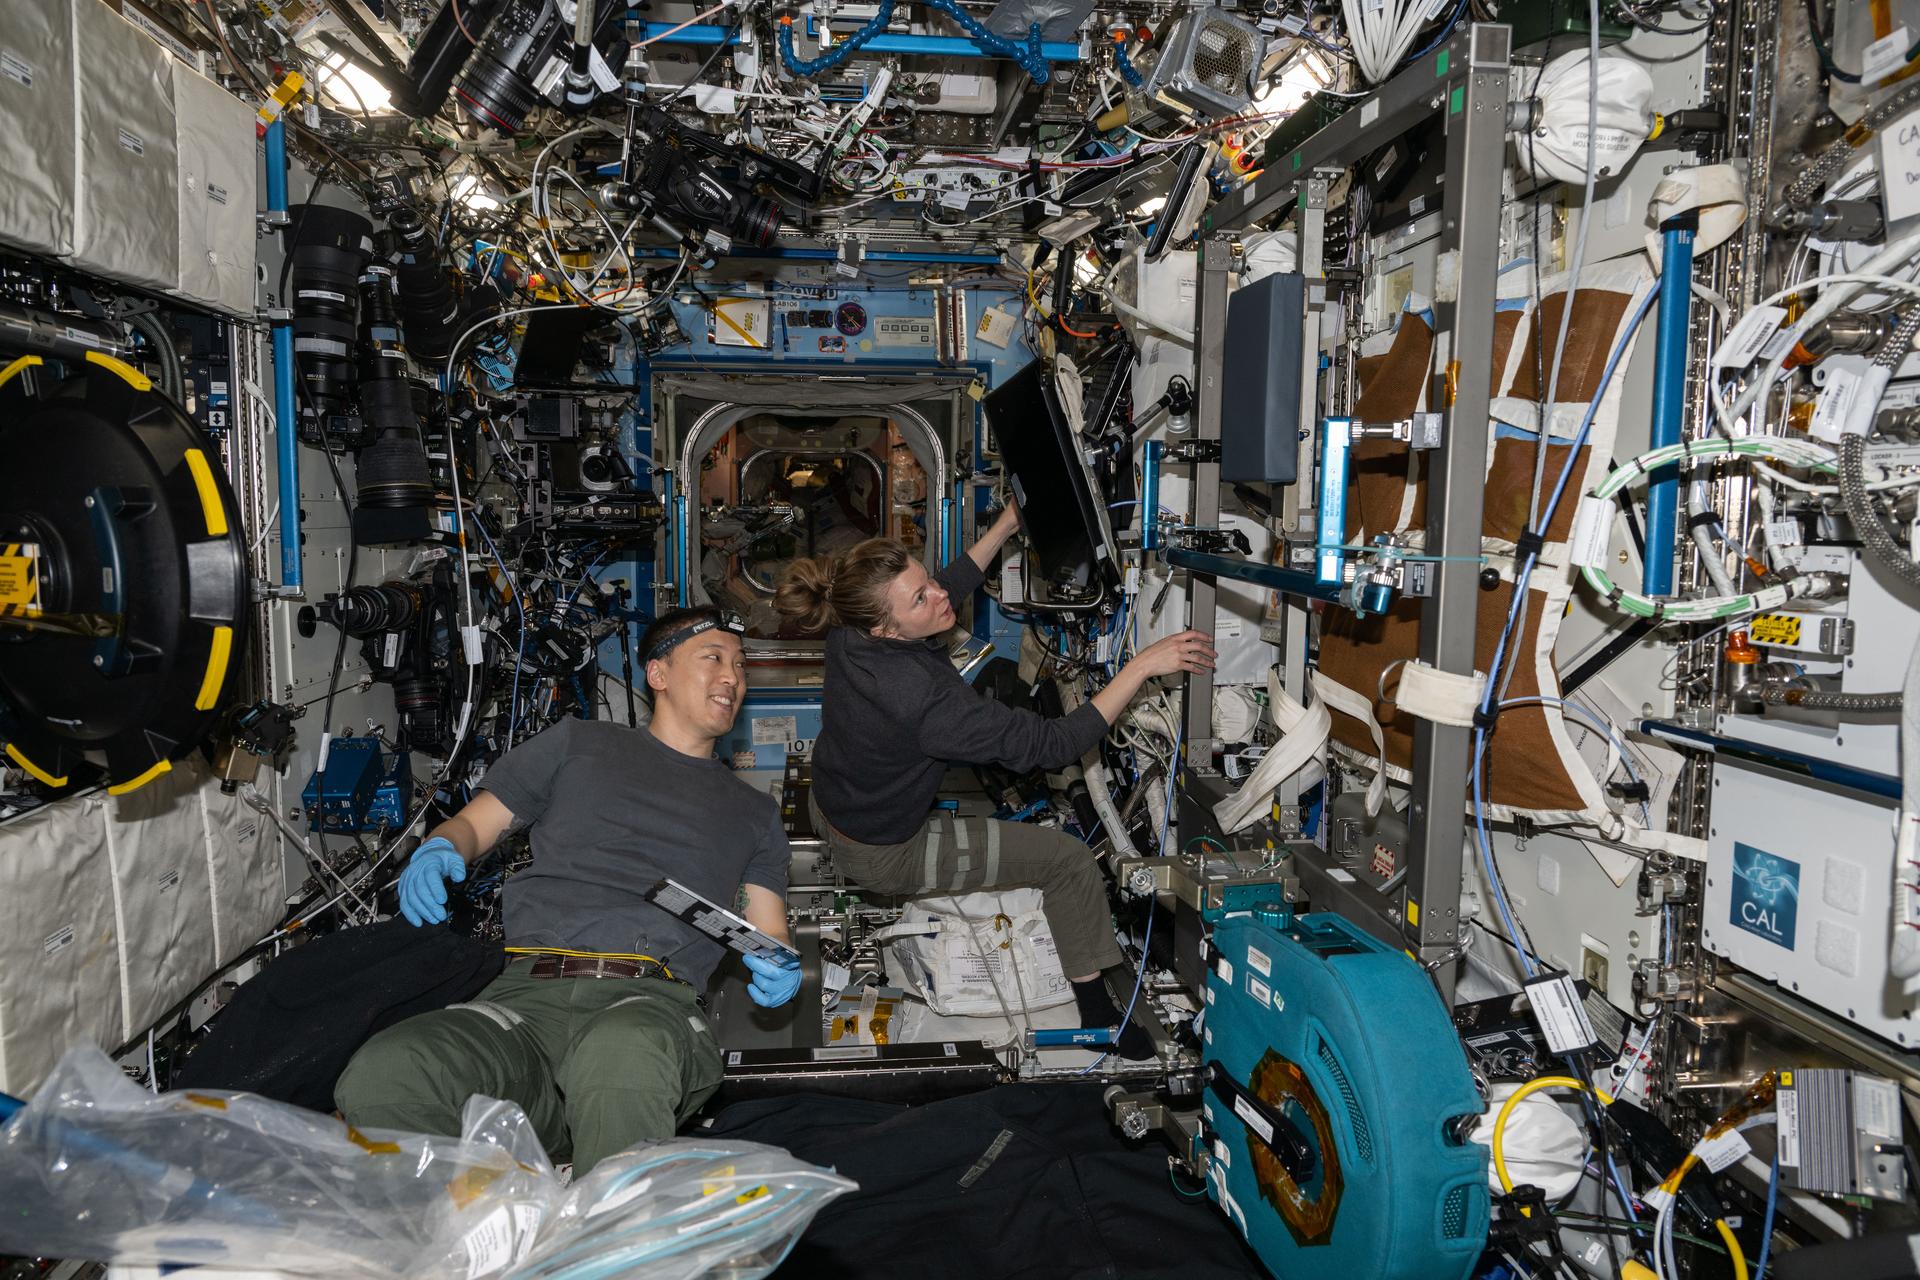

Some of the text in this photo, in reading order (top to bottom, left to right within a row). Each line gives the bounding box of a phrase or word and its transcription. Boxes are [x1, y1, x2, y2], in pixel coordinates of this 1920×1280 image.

[700, 181, 720, 200] Canon
[792, 287, 838, 300] OVD
[1741, 901, 1783, 936] CAL
